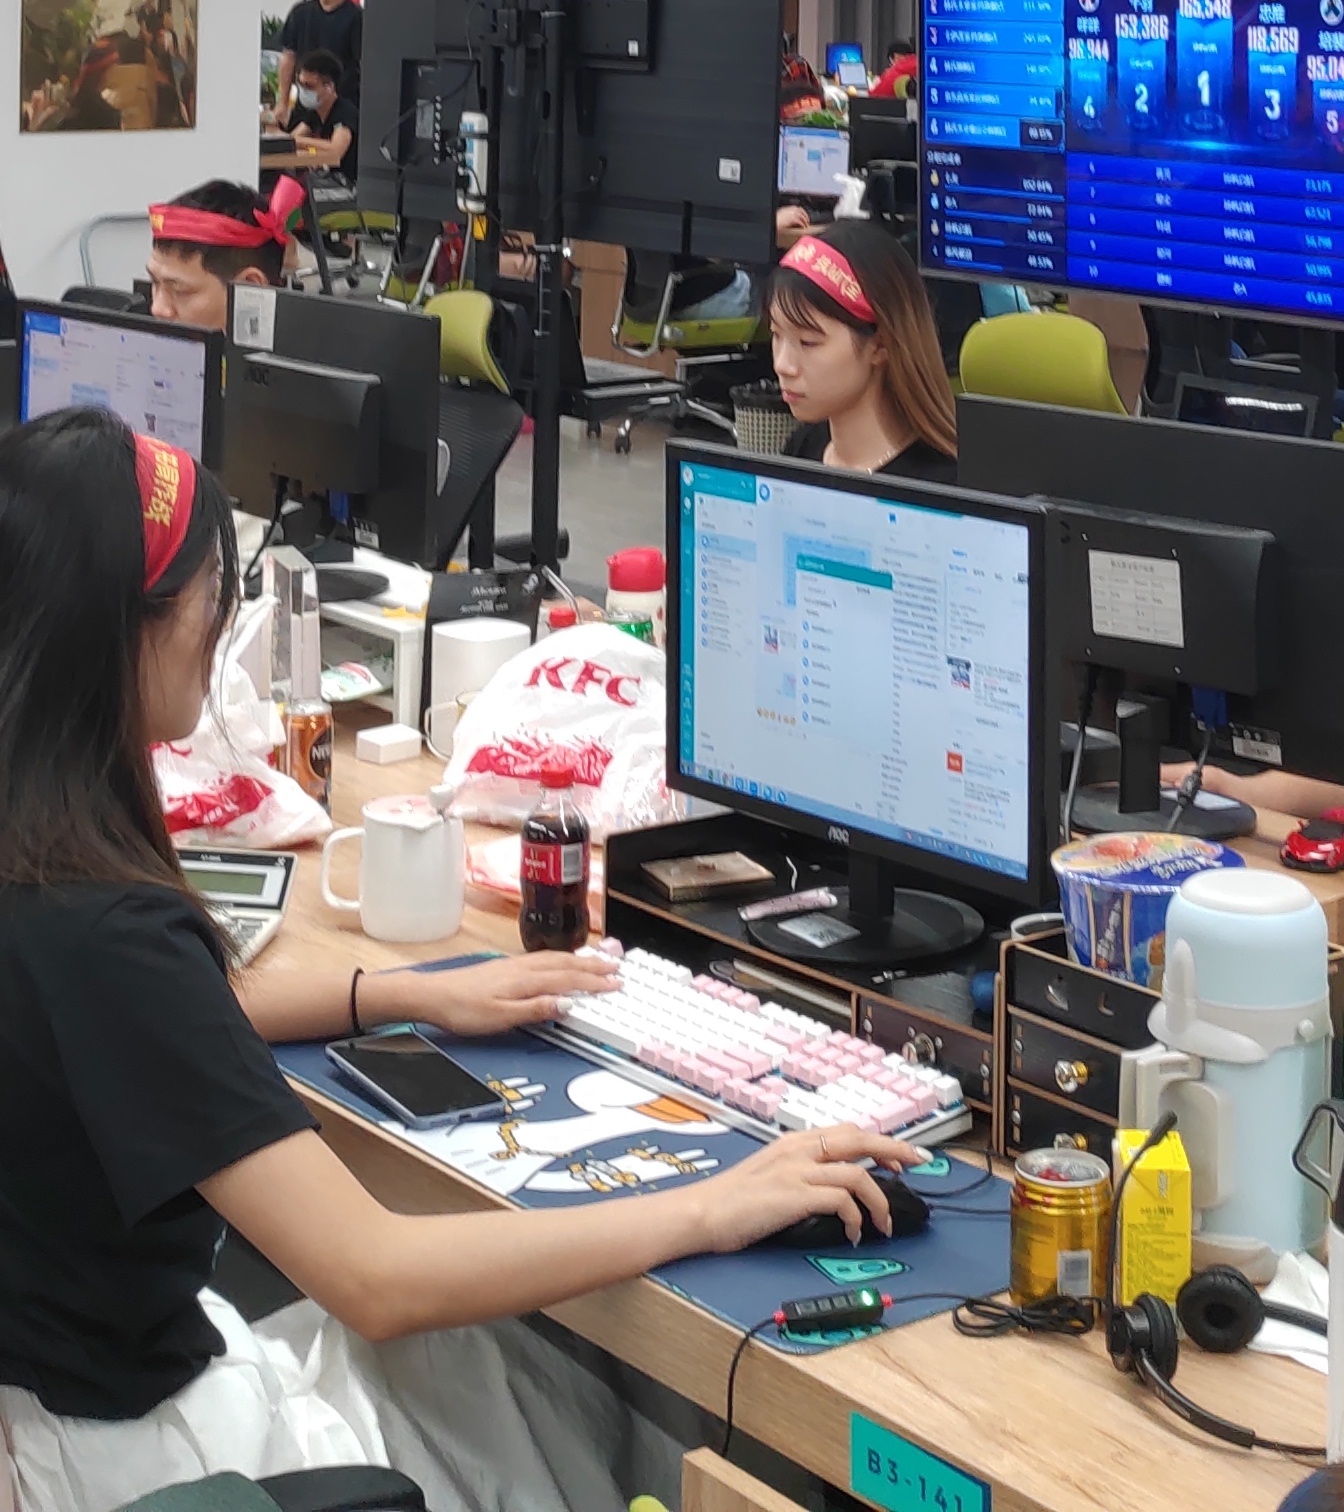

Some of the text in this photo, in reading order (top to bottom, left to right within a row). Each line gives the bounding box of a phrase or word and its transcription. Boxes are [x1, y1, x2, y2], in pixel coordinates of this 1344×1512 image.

[1134, 83, 1149, 114] 2
[1264, 89, 1281, 121] 3
[1326, 110, 1339, 134] 5
[525, 656, 642, 708] KFC
[827, 825, 851, 844] AOC
